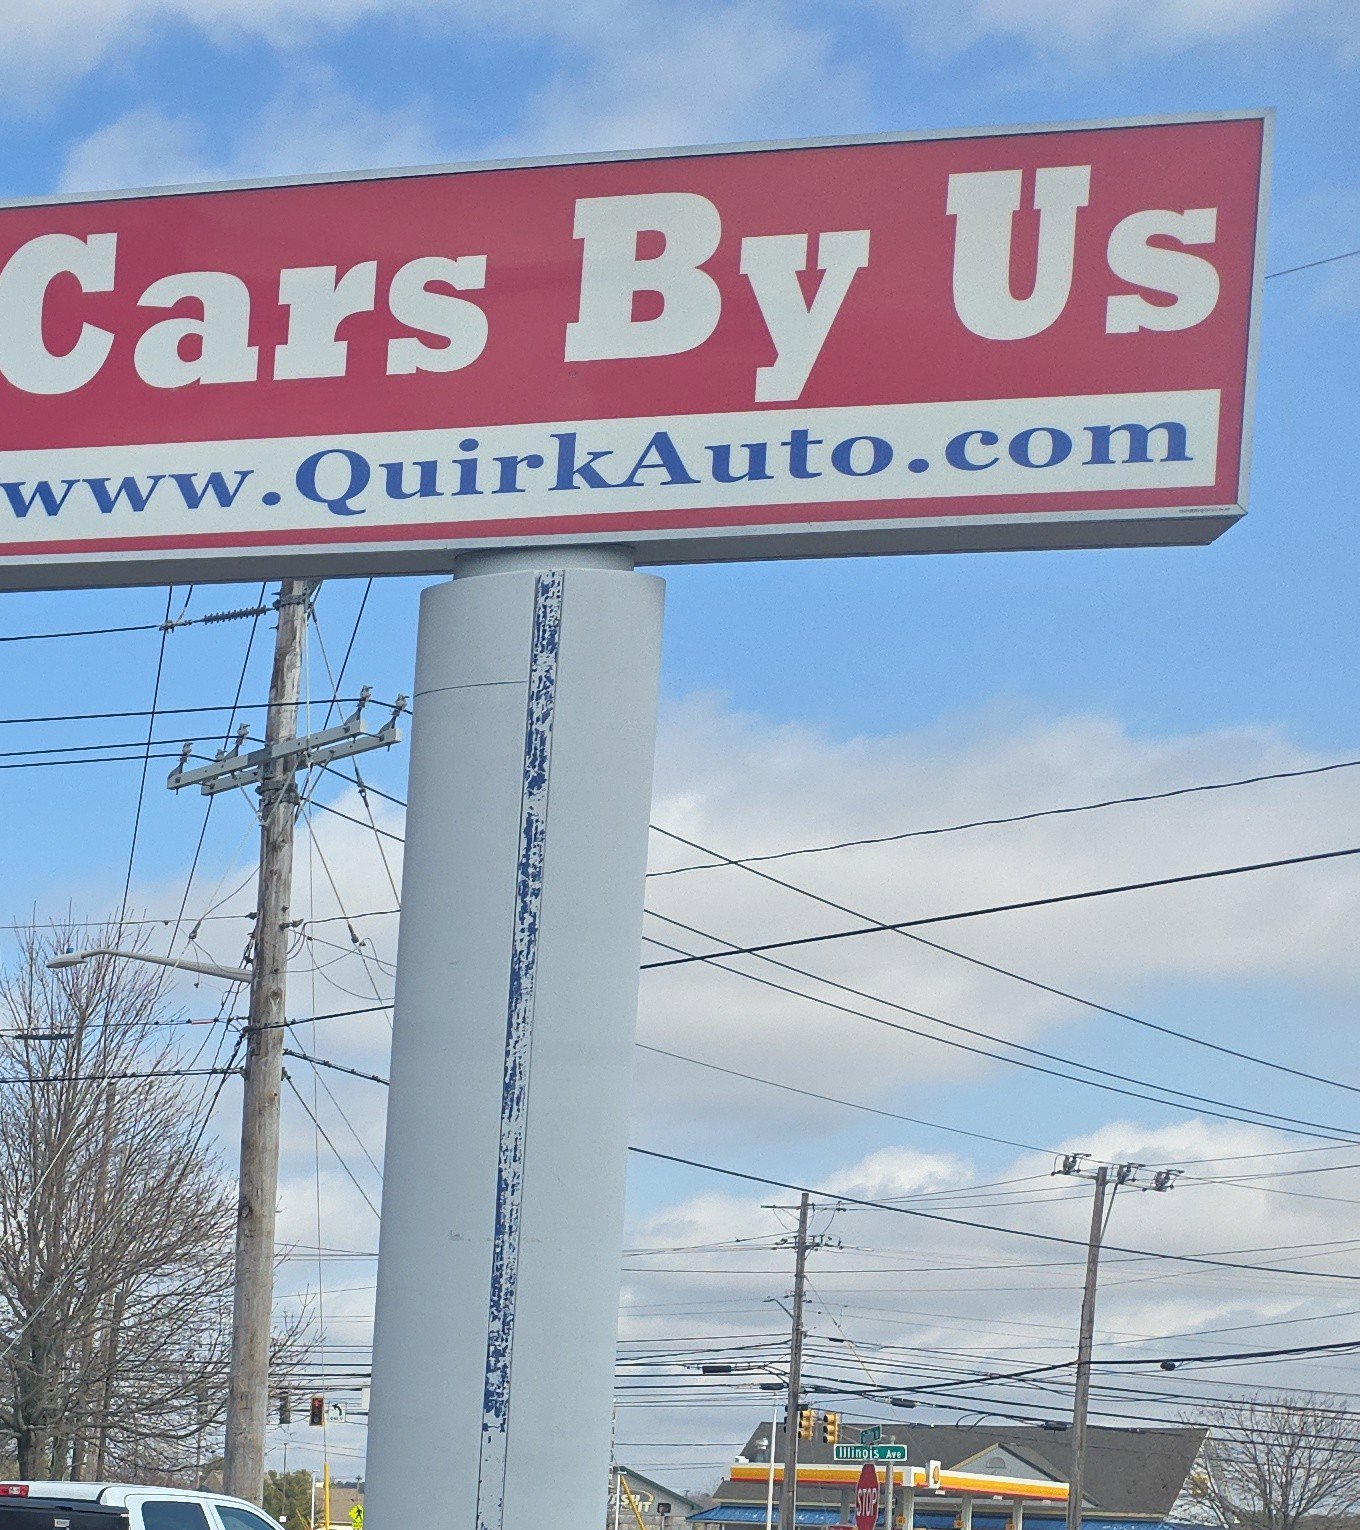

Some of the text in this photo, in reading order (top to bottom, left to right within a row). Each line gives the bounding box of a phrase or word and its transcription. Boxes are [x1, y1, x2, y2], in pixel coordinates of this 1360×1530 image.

[563, 191, 869, 403] By
[945, 165, 1222, 343] Us
[839, 1446, 902, 1459] Illinois Ave
[857, 1487, 878, 1516] STOP
